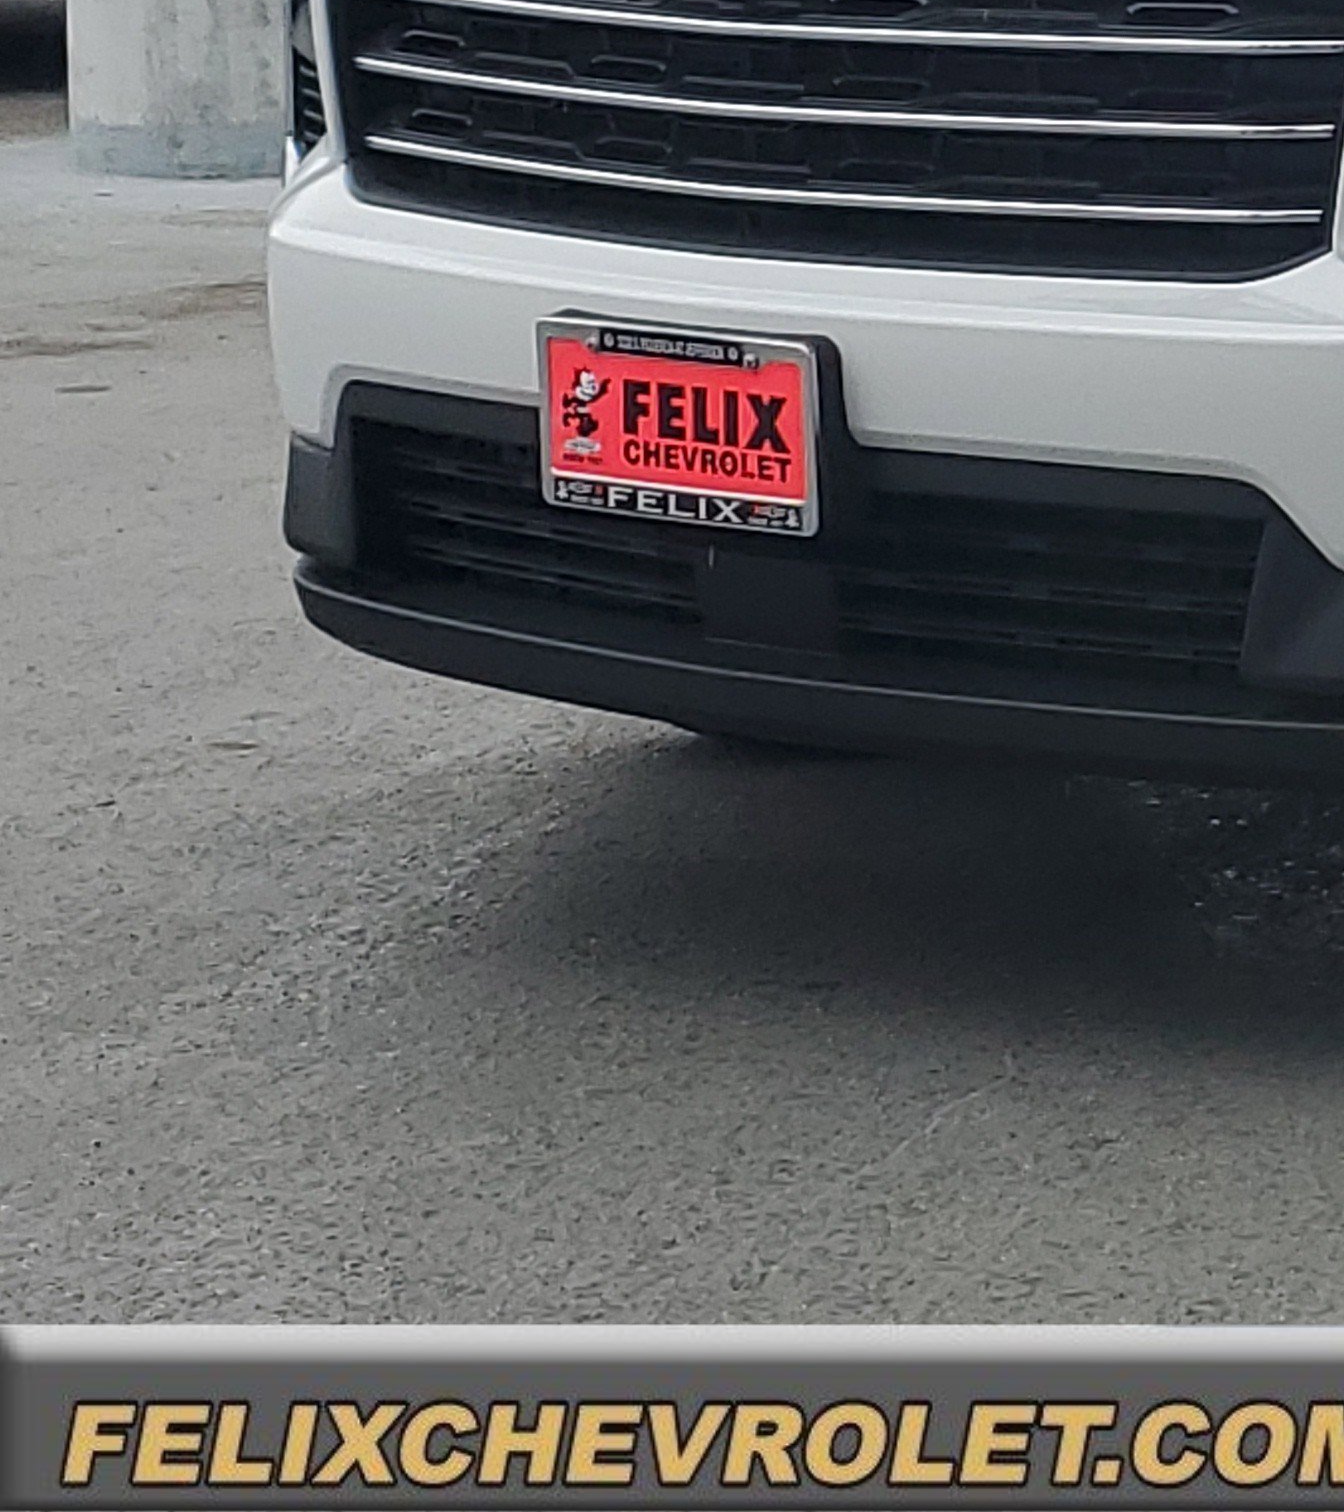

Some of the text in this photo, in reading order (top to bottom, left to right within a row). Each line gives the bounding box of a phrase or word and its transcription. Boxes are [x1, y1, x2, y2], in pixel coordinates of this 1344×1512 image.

[621, 377, 791, 455] FELIX
[622, 438, 792, 484] CHEVROLET
[606, 486, 743, 525] FELIX
